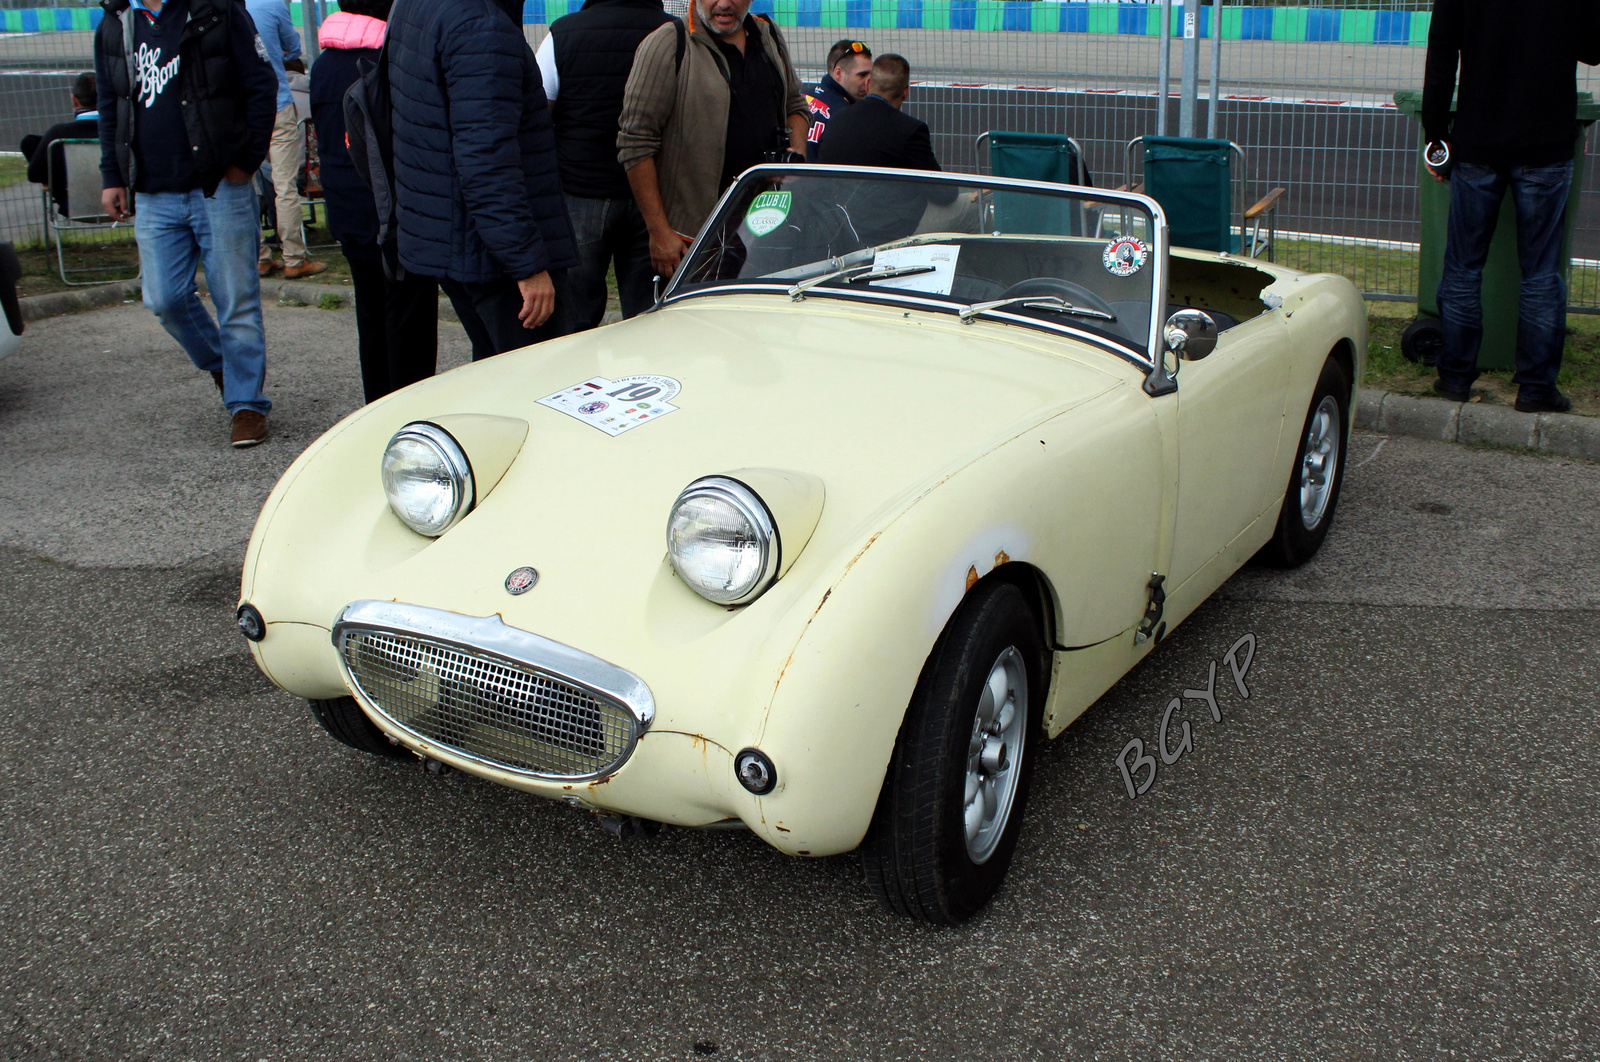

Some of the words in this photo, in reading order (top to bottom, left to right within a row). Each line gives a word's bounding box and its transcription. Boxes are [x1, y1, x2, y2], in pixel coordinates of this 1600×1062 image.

[755, 194, 780, 209] CLUB
[1116, 236, 1140, 244] MOTOR
[605, 382, 661, 402] 19
